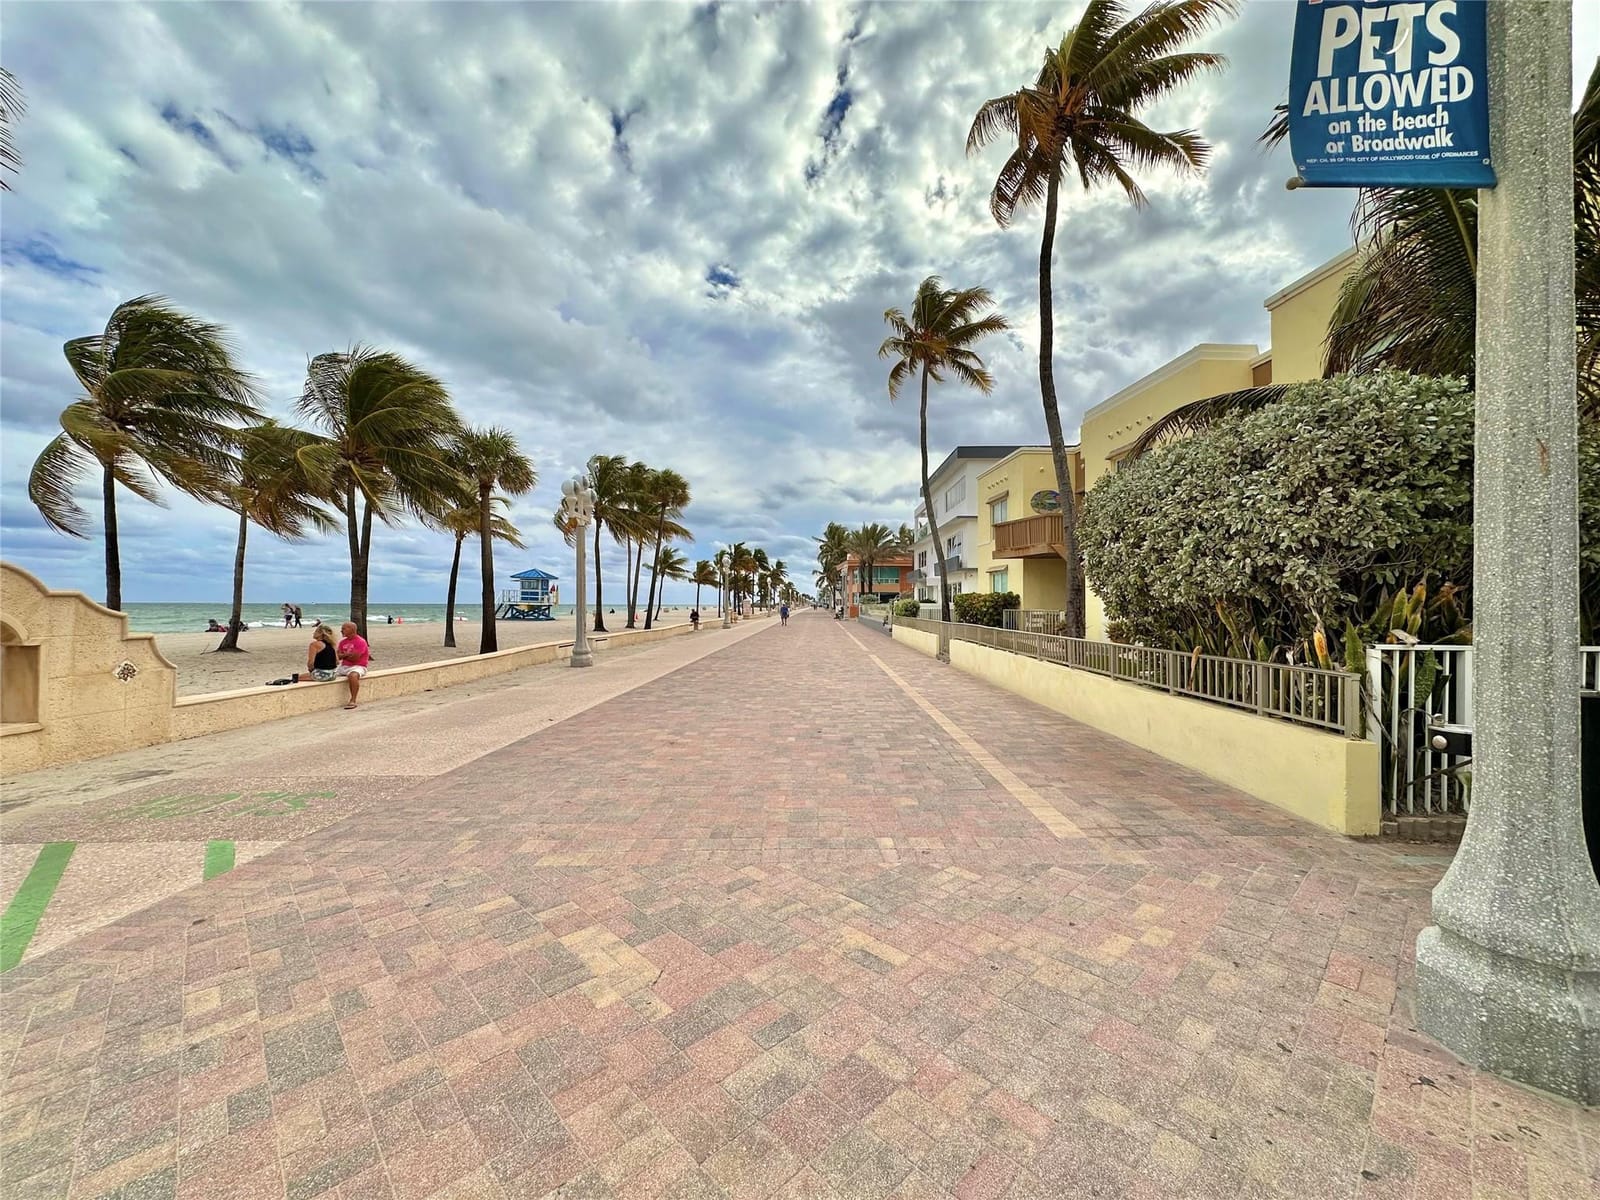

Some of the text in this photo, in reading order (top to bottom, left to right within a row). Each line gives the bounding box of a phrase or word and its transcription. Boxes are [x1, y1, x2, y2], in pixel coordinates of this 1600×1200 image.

[1317, 1, 1461, 78] PETS
[1302, 66, 1474, 117] ALLOWED
[1328, 104, 1449, 134] on the beach
[1326, 126, 1454, 153] or Broadwalk
[1431, 152, 1441, 160] OF
